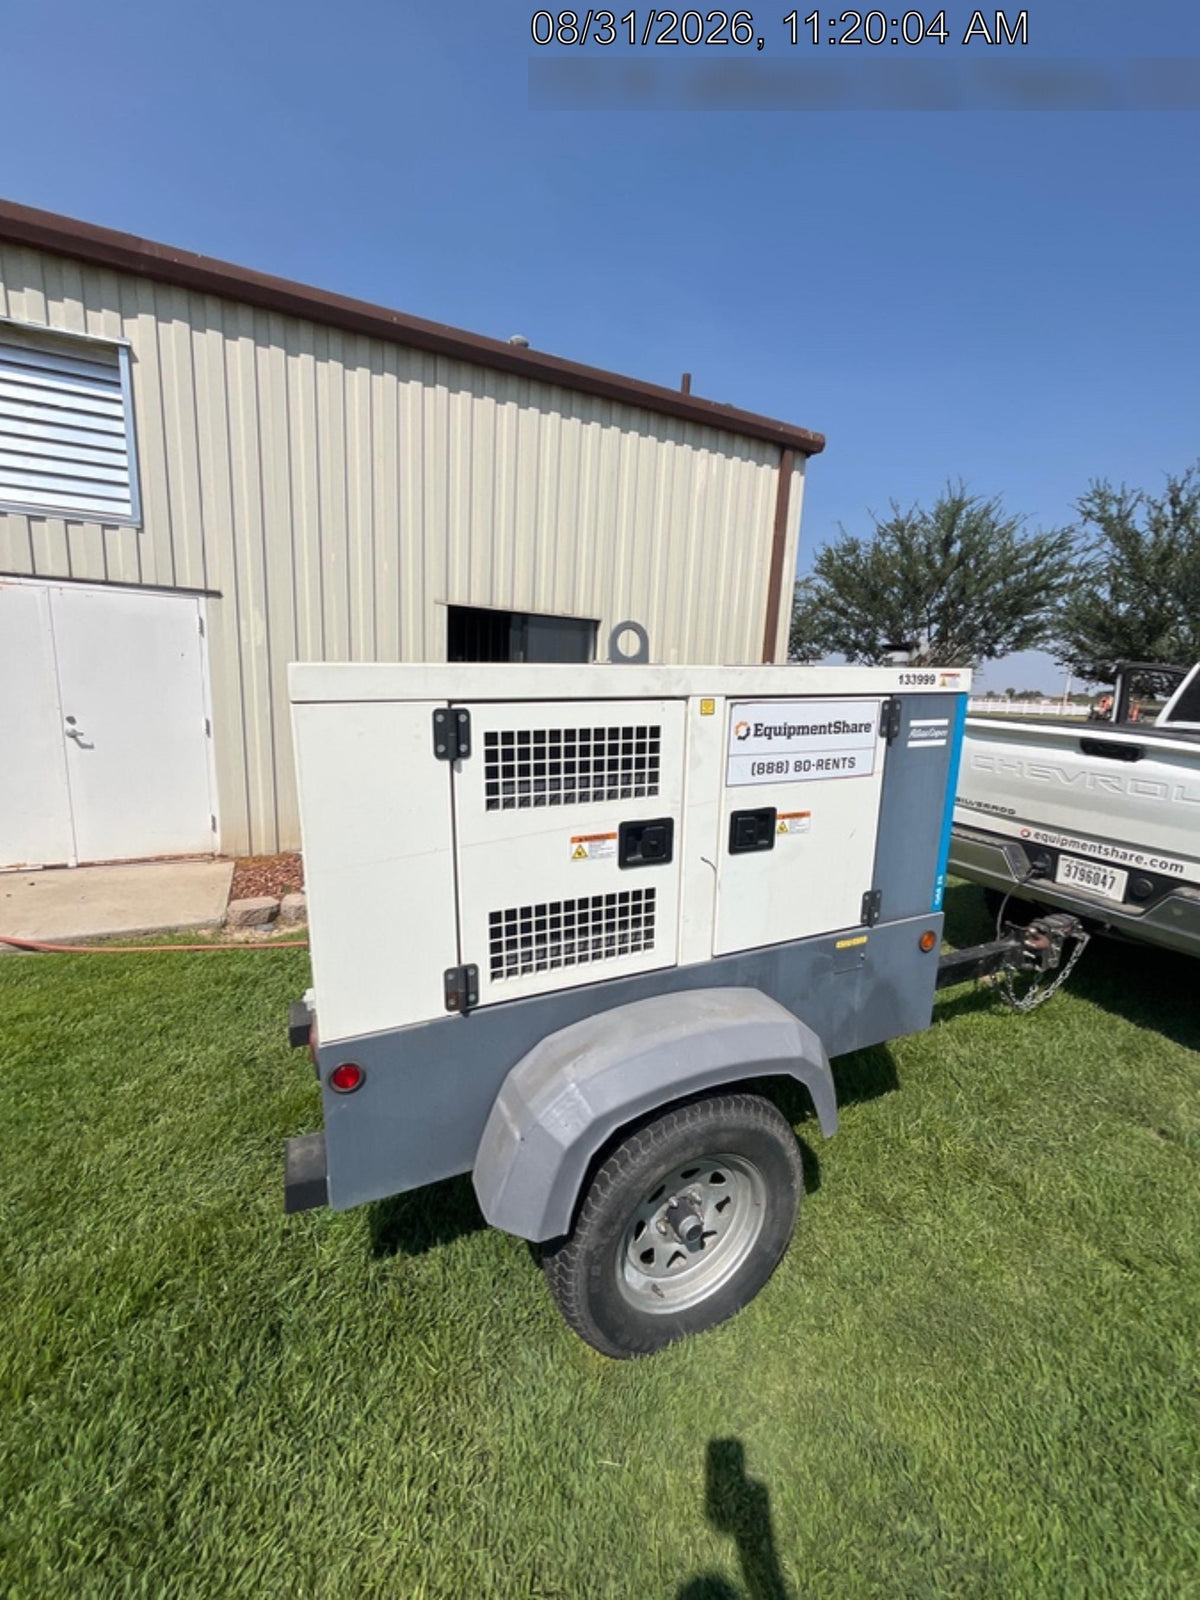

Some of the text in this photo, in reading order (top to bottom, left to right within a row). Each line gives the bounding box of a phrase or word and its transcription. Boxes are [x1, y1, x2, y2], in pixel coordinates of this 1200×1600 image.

[899, 673, 936, 685] 133999
[753, 720, 872, 740] EquipmentShare
[751, 760, 790, 776] (888)
[1033, 830, 1184, 874] equipmentshare.com
[1064, 863, 1116, 890] 3796047
